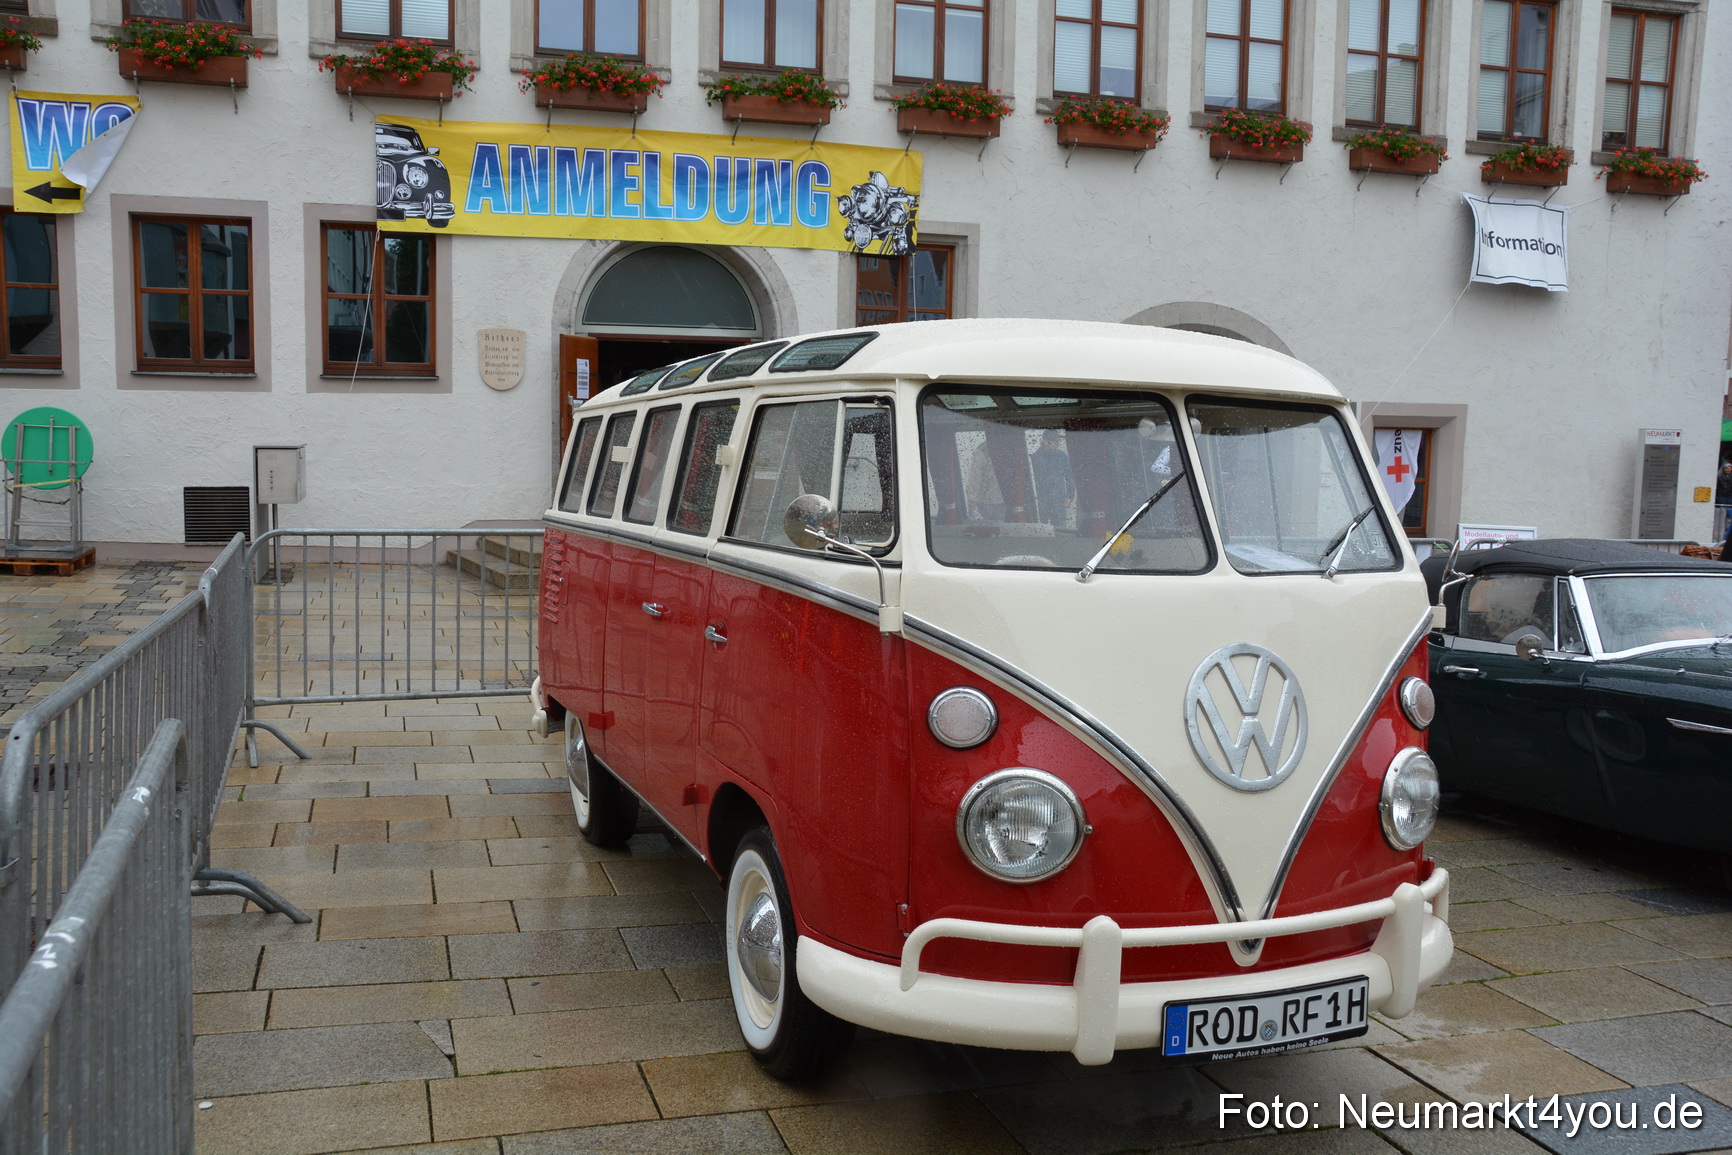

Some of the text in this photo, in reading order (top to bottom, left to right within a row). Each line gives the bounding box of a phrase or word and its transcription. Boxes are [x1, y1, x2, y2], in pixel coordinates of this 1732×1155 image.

[464, 142, 831, 228] ANMELDUNG
[1481, 227, 1562, 258] Information
[1464, 531, 1504, 539] Modellauto-
[1187, 1005, 1259, 1048] ROD
[1171, 1036, 1180, 1047] D
[1211, 1036, 1330, 1061] Neue Autos haben keine Seele
